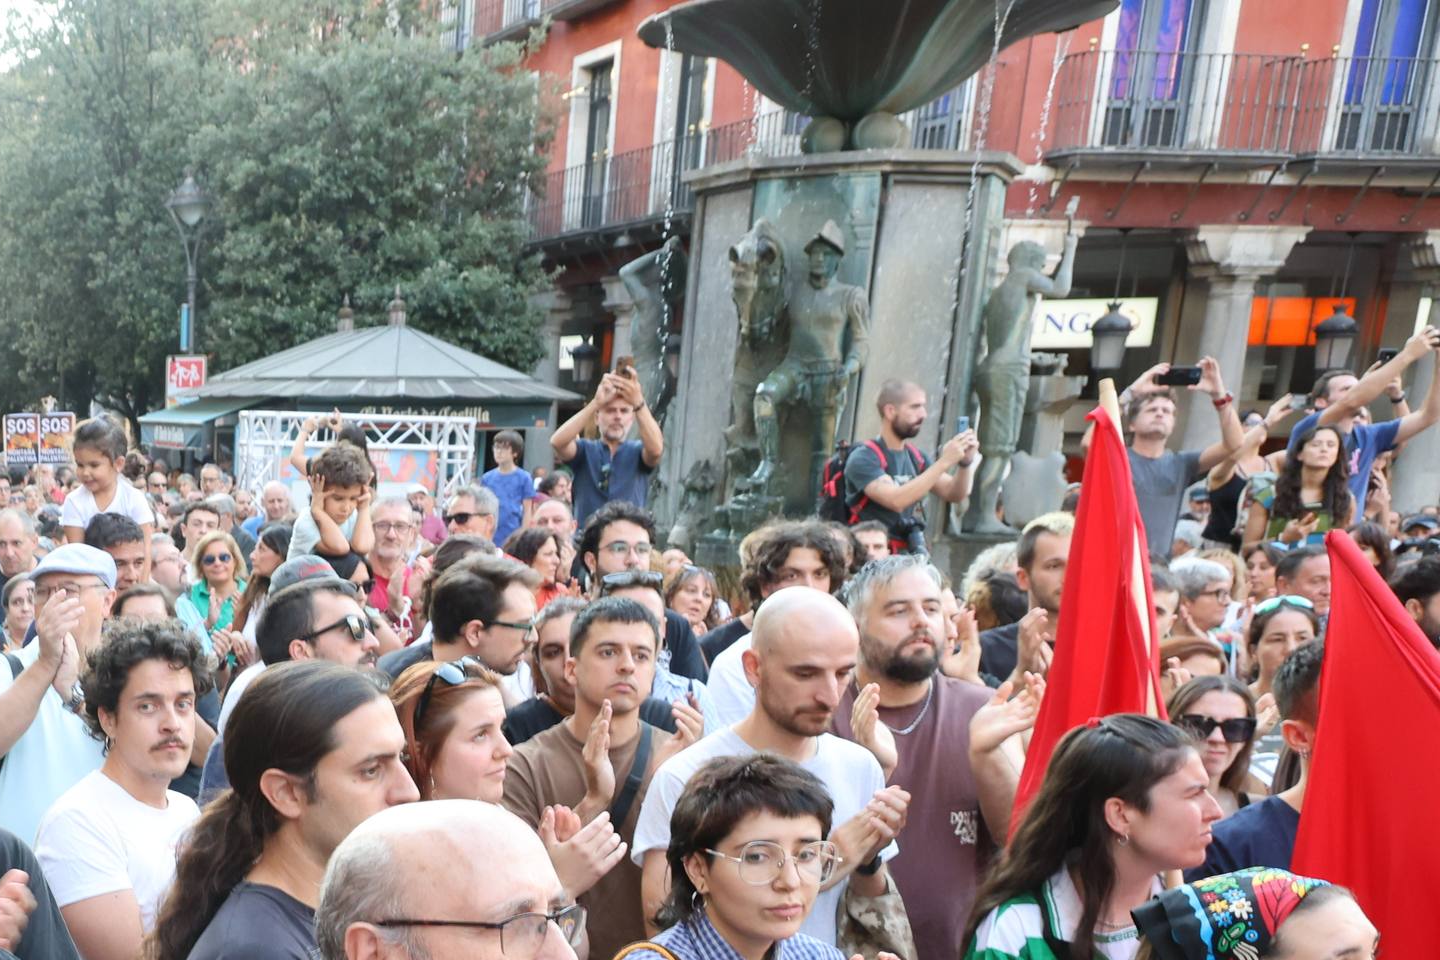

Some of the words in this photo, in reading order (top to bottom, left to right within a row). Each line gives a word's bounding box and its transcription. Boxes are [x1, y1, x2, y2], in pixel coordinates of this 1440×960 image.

[1042, 311, 1091, 334] NG
[7, 419, 35, 434] SOS
[41, 418, 69, 432] SOS
